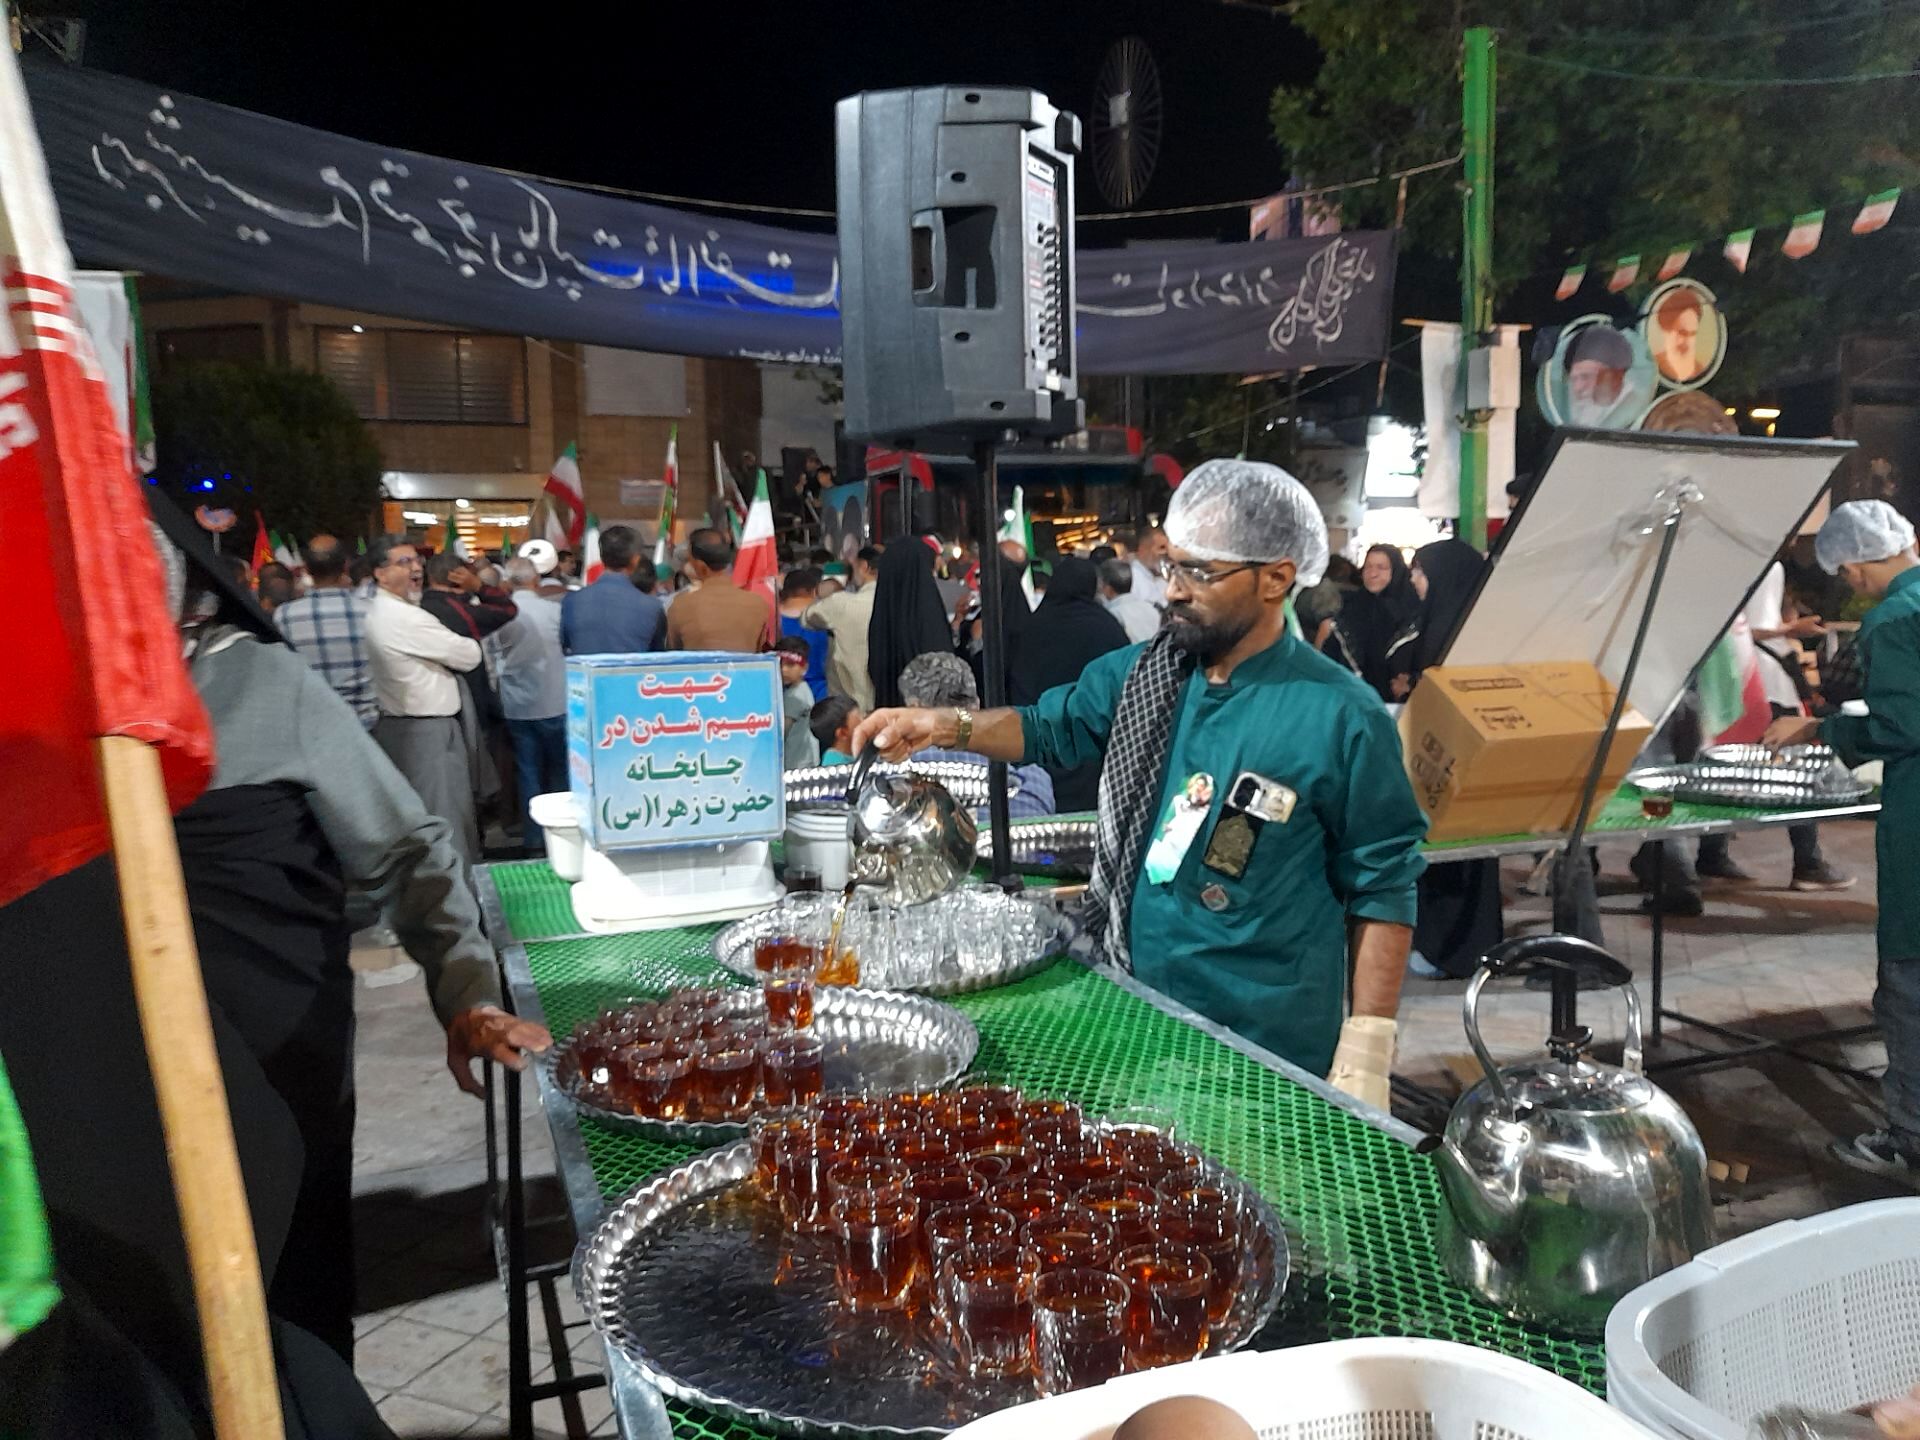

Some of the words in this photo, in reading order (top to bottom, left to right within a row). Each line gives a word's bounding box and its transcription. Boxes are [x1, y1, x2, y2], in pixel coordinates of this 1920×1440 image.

[641, 675, 729, 701] جهت
[600, 716, 627, 747] در
[632, 708, 701, 744] شدن
[706, 714, 772, 739] سهیم
[626, 752, 743, 784] چایخانه
[705, 788, 774, 822] حضرت
